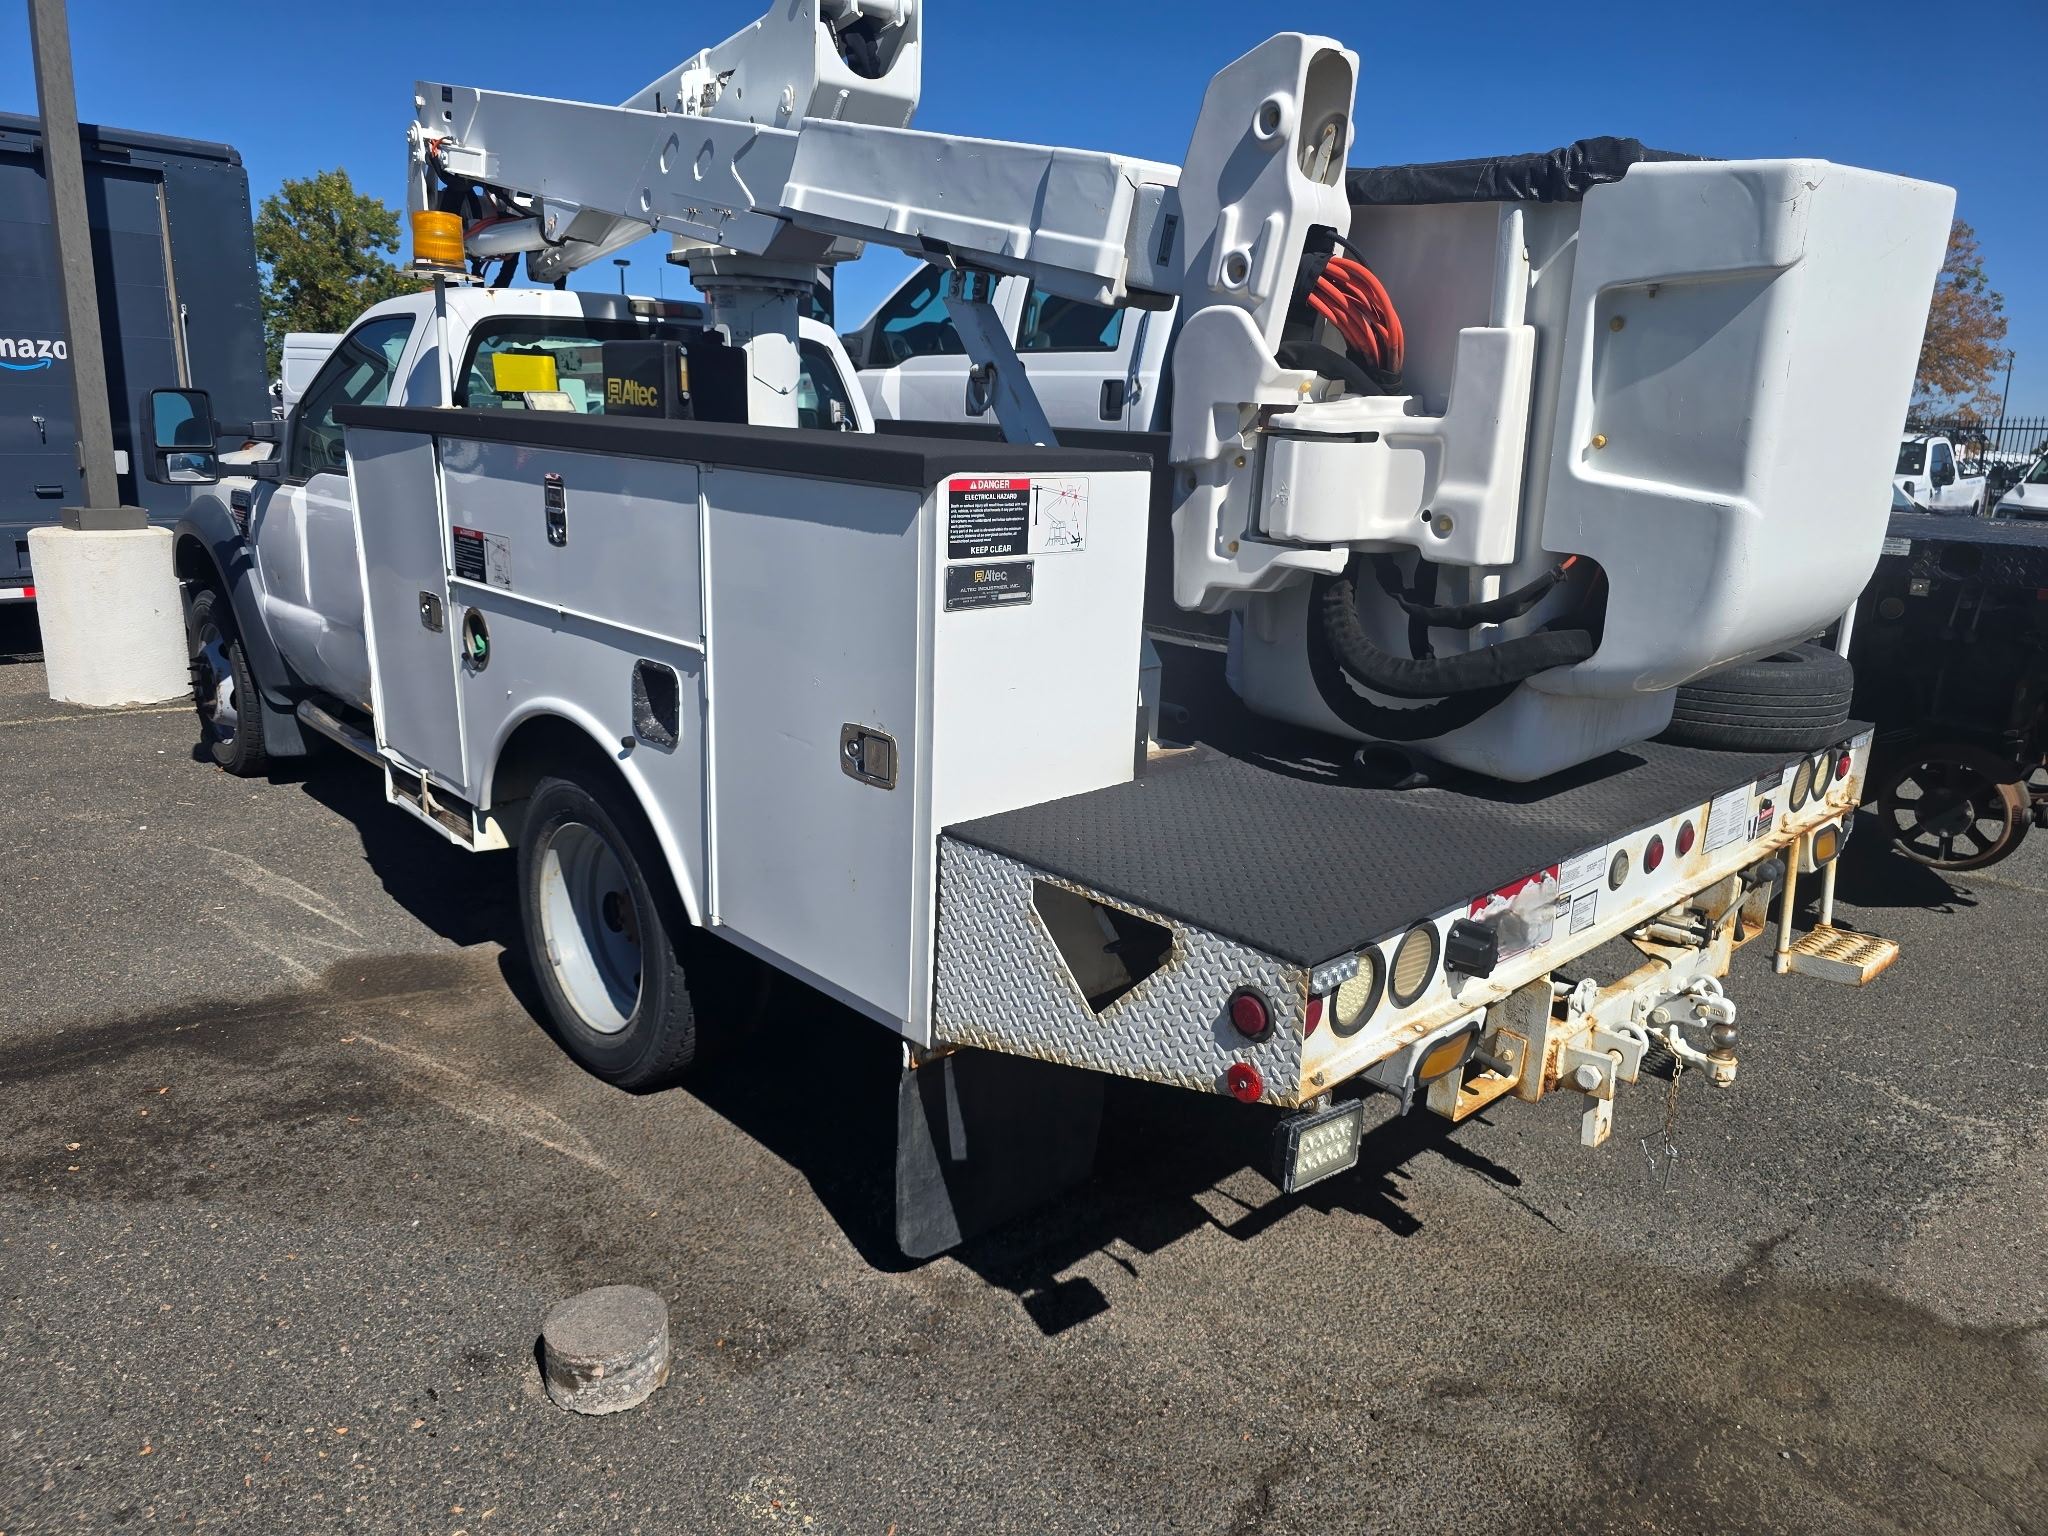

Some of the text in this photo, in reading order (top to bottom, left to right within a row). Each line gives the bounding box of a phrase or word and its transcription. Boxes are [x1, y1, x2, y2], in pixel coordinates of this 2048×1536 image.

[0, 338, 68, 360] mazo
[622, 379, 658, 408] Altec
[978, 480, 1010, 489] DANGER
[970, 544, 1012, 555] KEEP CLEAR
[984, 569, 1008, 582] Altec
